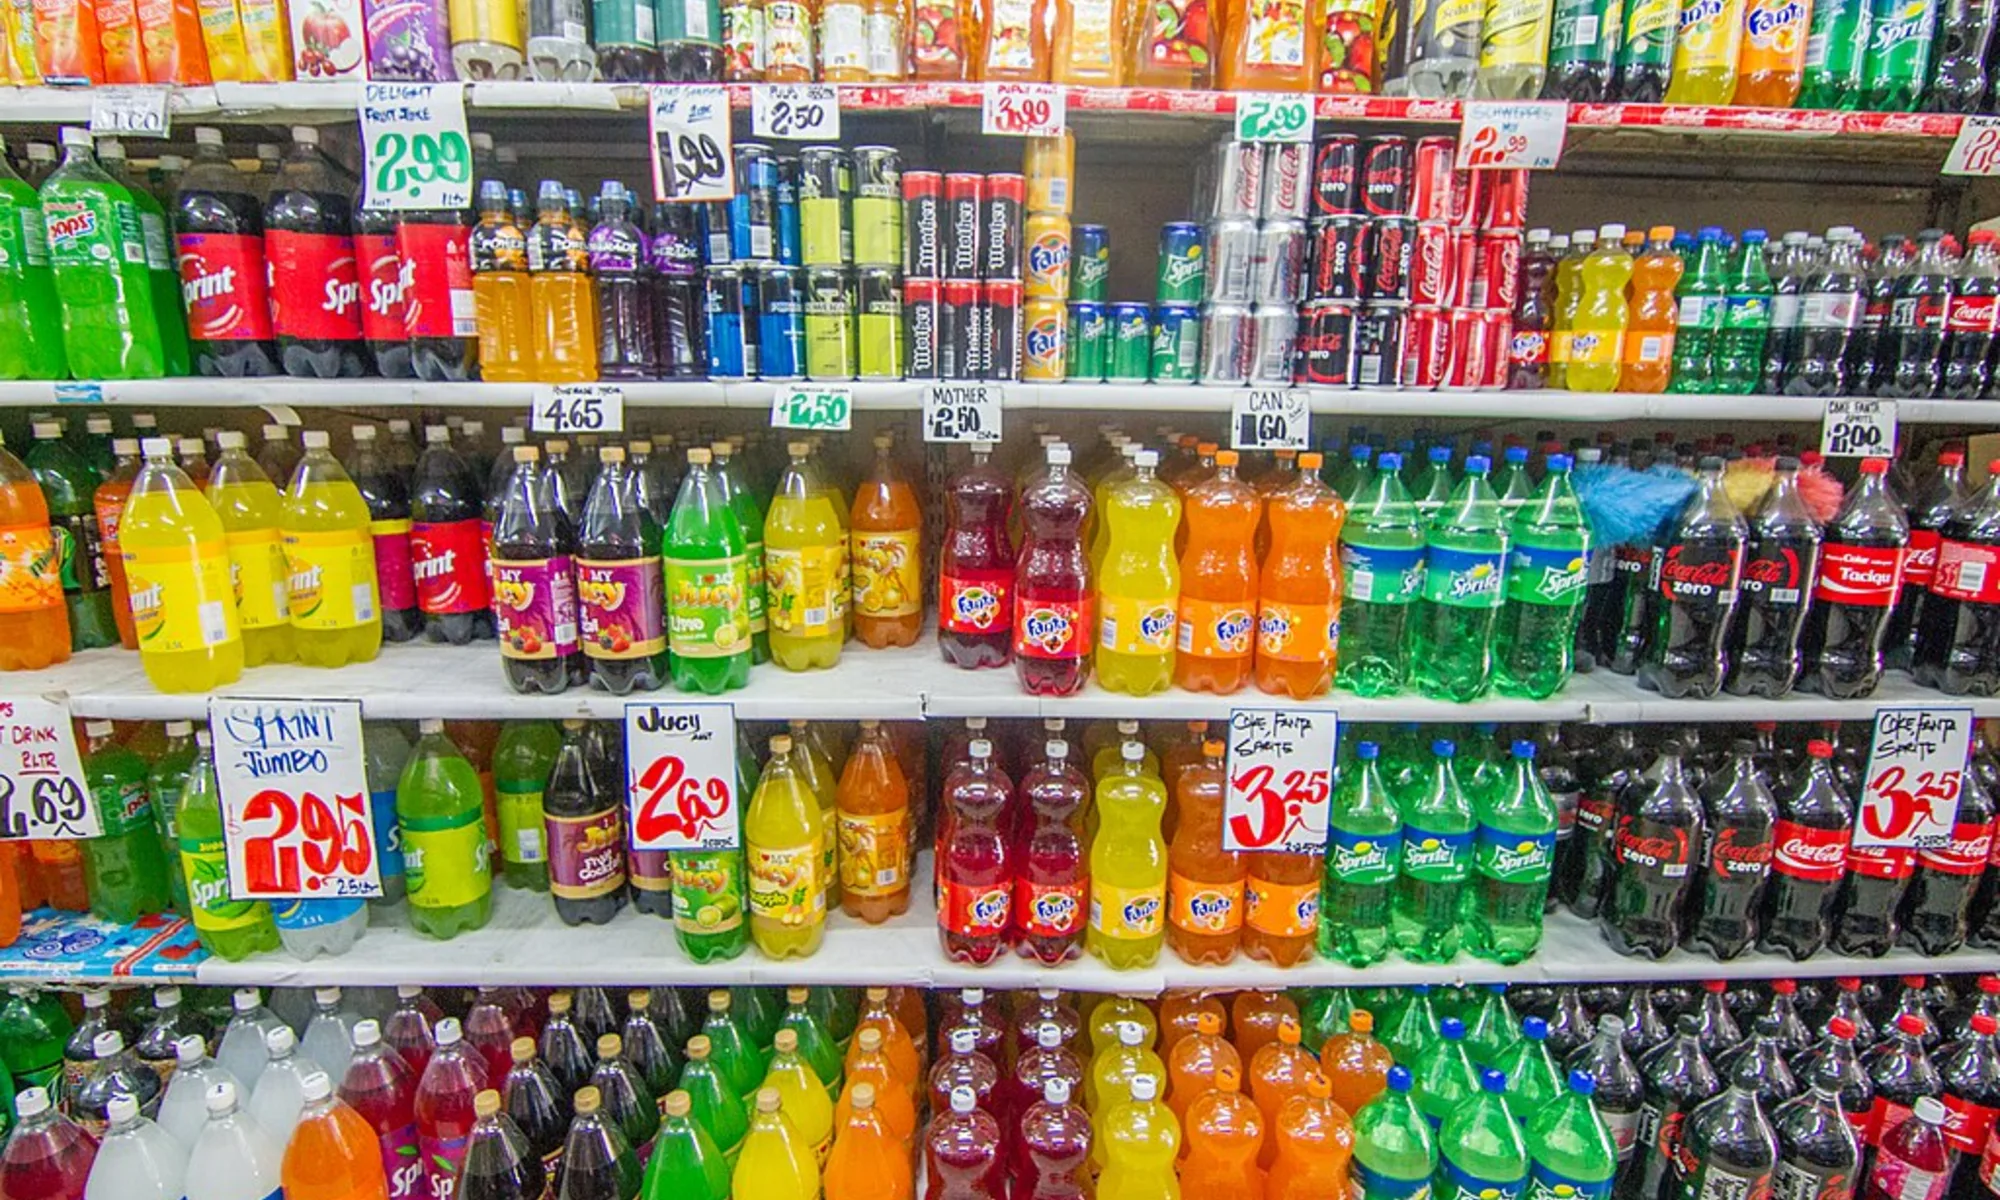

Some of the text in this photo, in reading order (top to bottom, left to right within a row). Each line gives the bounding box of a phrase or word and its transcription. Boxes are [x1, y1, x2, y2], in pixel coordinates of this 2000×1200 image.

[1680, 0, 1721, 26] anta
[1320, 182, 1346, 192] zero
[1368, 183, 1394, 194] zero
[933, 387, 988, 405] MOTHER
[1619, 561, 1641, 573] ero
[1673, 580, 1712, 597] zero
[1027, 617, 1067, 637] Fanta
[1259, 619, 1287, 634] anta
[12, 725, 58, 745] DRINK
[225, 706, 336, 749] SPRINT
[1622, 846, 1658, 867] zero
[1782, 838, 1848, 863] Coca-Cola
[1726, 859, 1762, 874] zero
